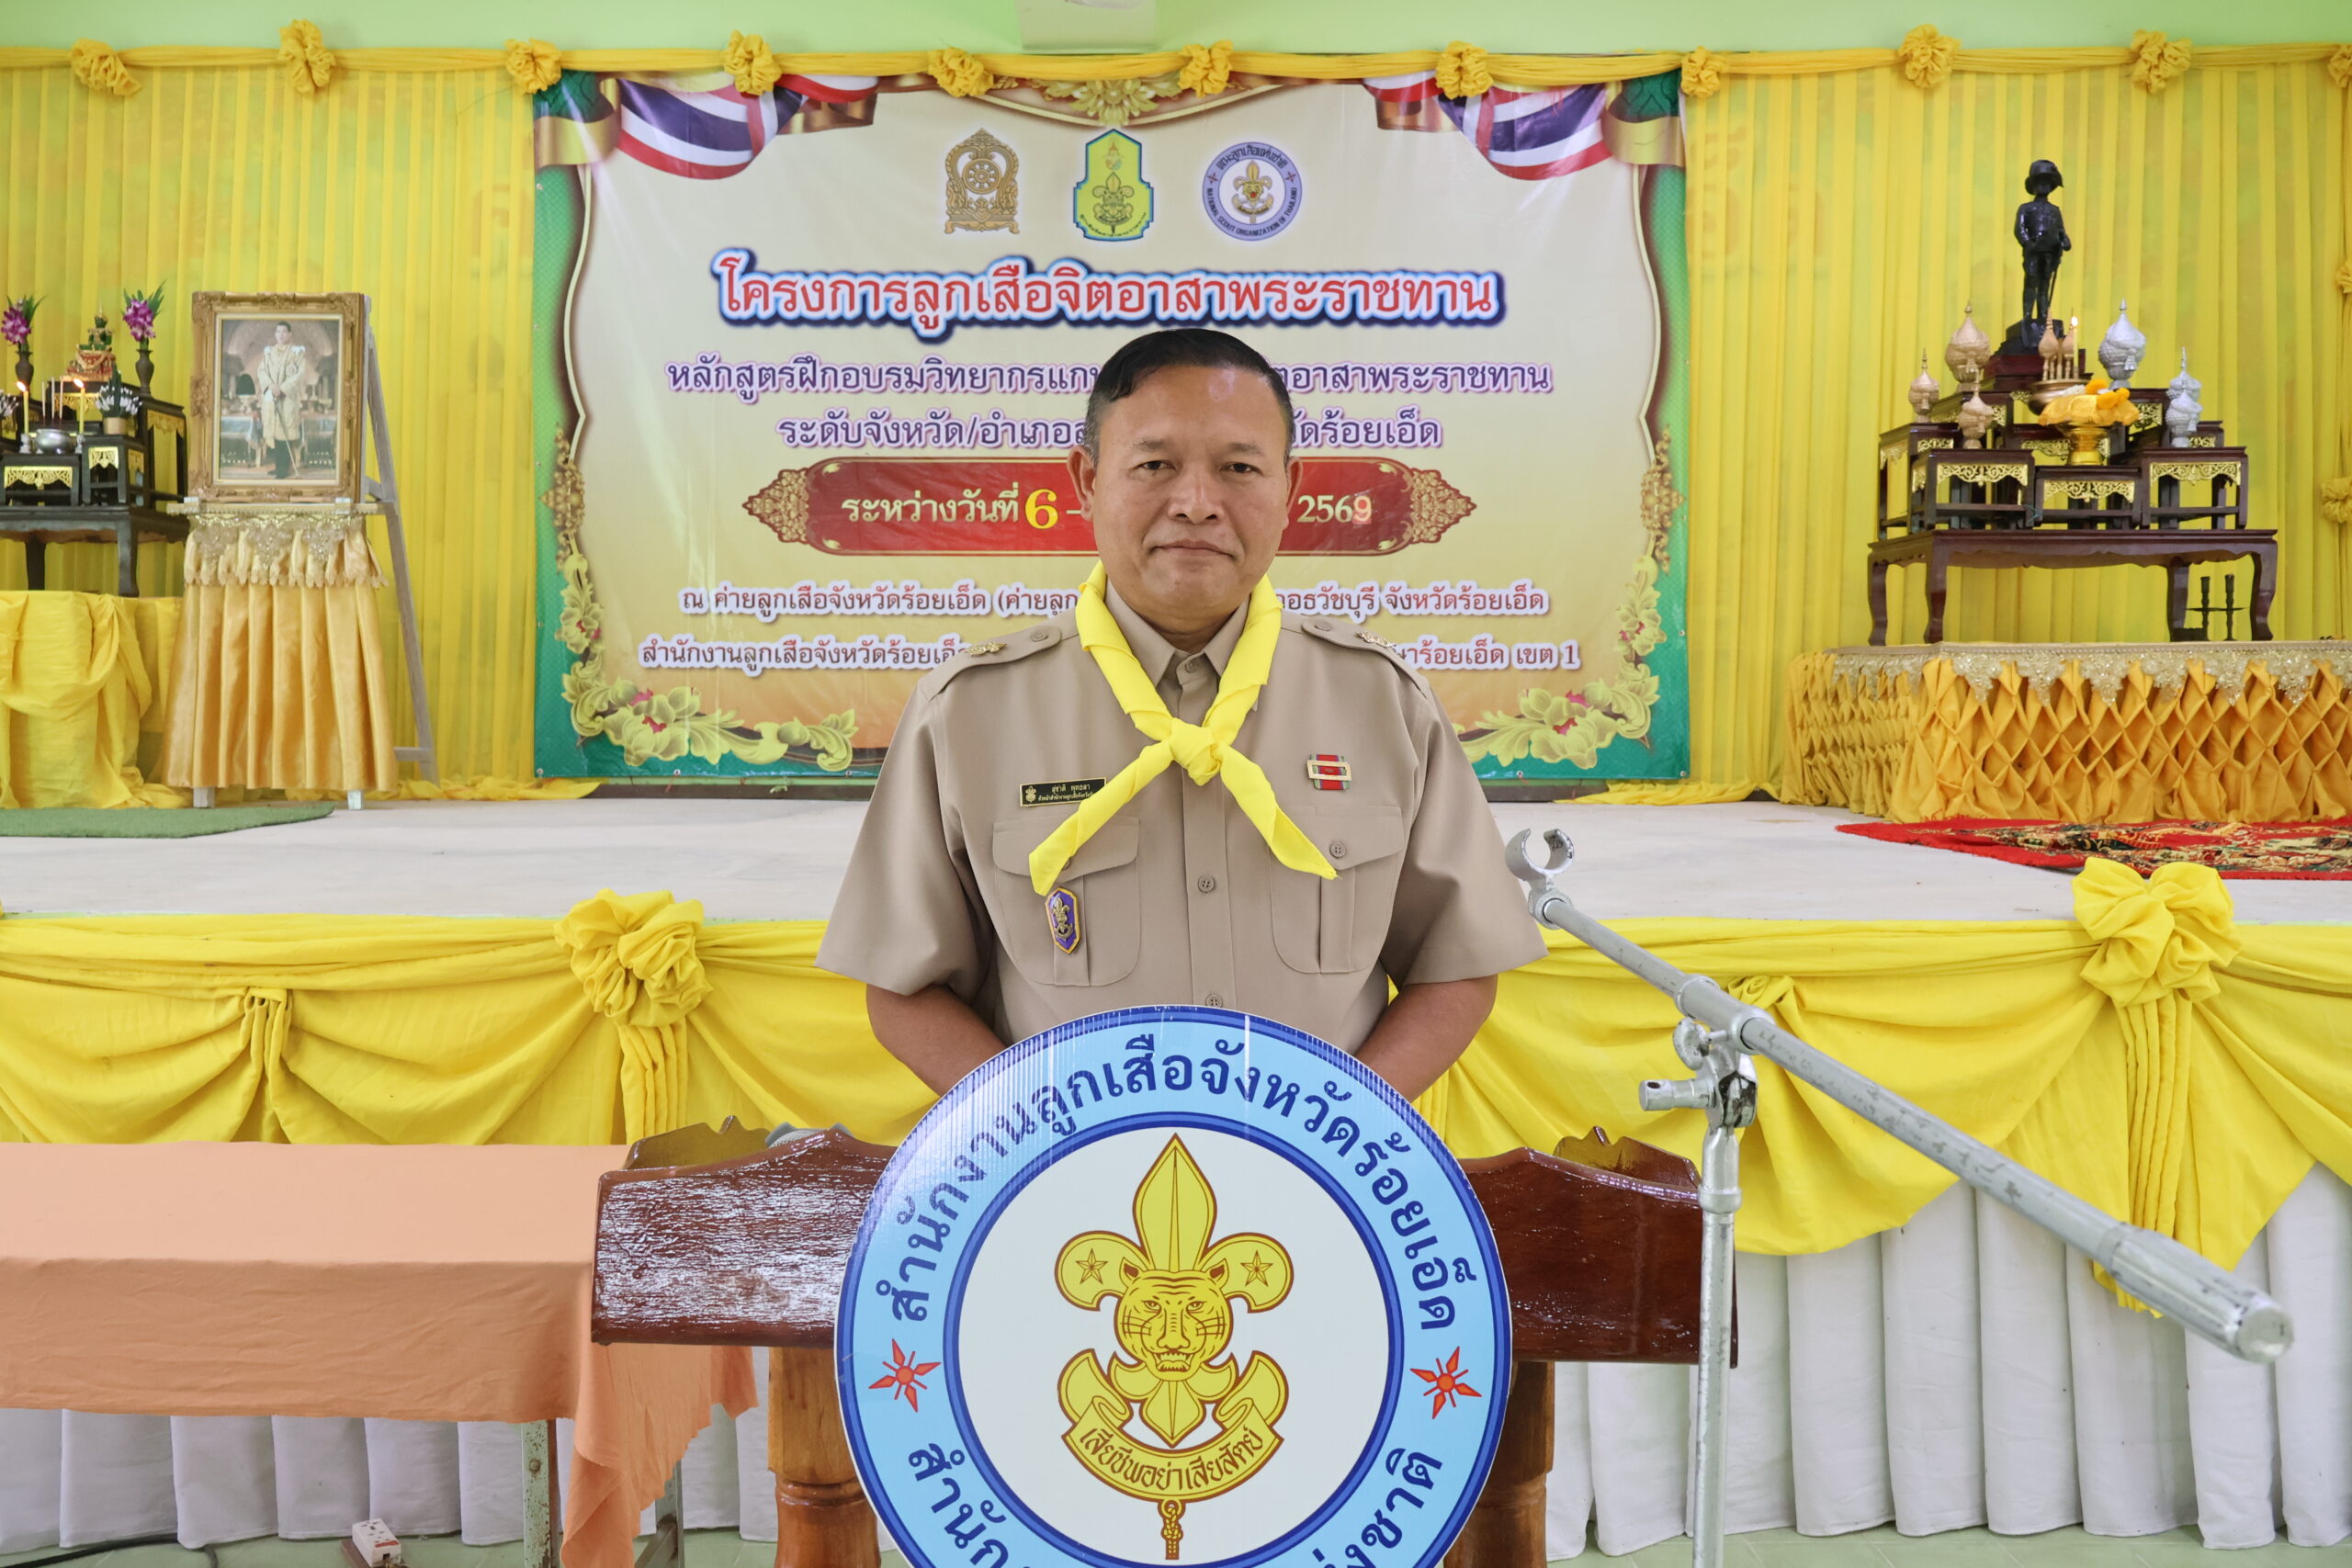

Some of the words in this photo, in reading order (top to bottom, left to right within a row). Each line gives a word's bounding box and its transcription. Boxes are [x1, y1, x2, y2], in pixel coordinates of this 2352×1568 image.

[1206, 187, 1220, 217] NATIONAL
[1217, 216, 1237, 231] SCOUT
[1236, 222, 1281, 236] ORGANIZATION
[1283, 187, 1297, 217] THAILAND
[720, 256, 1492, 333] โครงการลูกเสือจิตอาสาพระราชทาน
[842, 481, 1019, 523] ระหว่างวันที่
[1025, 488, 1058, 529] 6
[1297, 494, 1373, 523] 2569
[683, 591, 704, 610] ณ
[715, 584, 987, 617] ค่ายลูกเสือจังหวัดร้อยเอ็ด
[1385, 582, 1544, 611] จังหวัดร้อยเอ็ด
[642, 637, 967, 671] สำนักงานลูกเสือจังหวัดร้อยเอ็
[1516, 649, 1554, 665] เขต
[1563, 644, 1579, 664] 1
[876, 1033, 1477, 1330] สำนักงานลูกเสือจังหวัดร้อยเอ็ด
[1080, 1425, 1264, 1491] เสียชีพอย่าเสียสัตย์
[908, 1443, 1031, 1568] สำนัก
